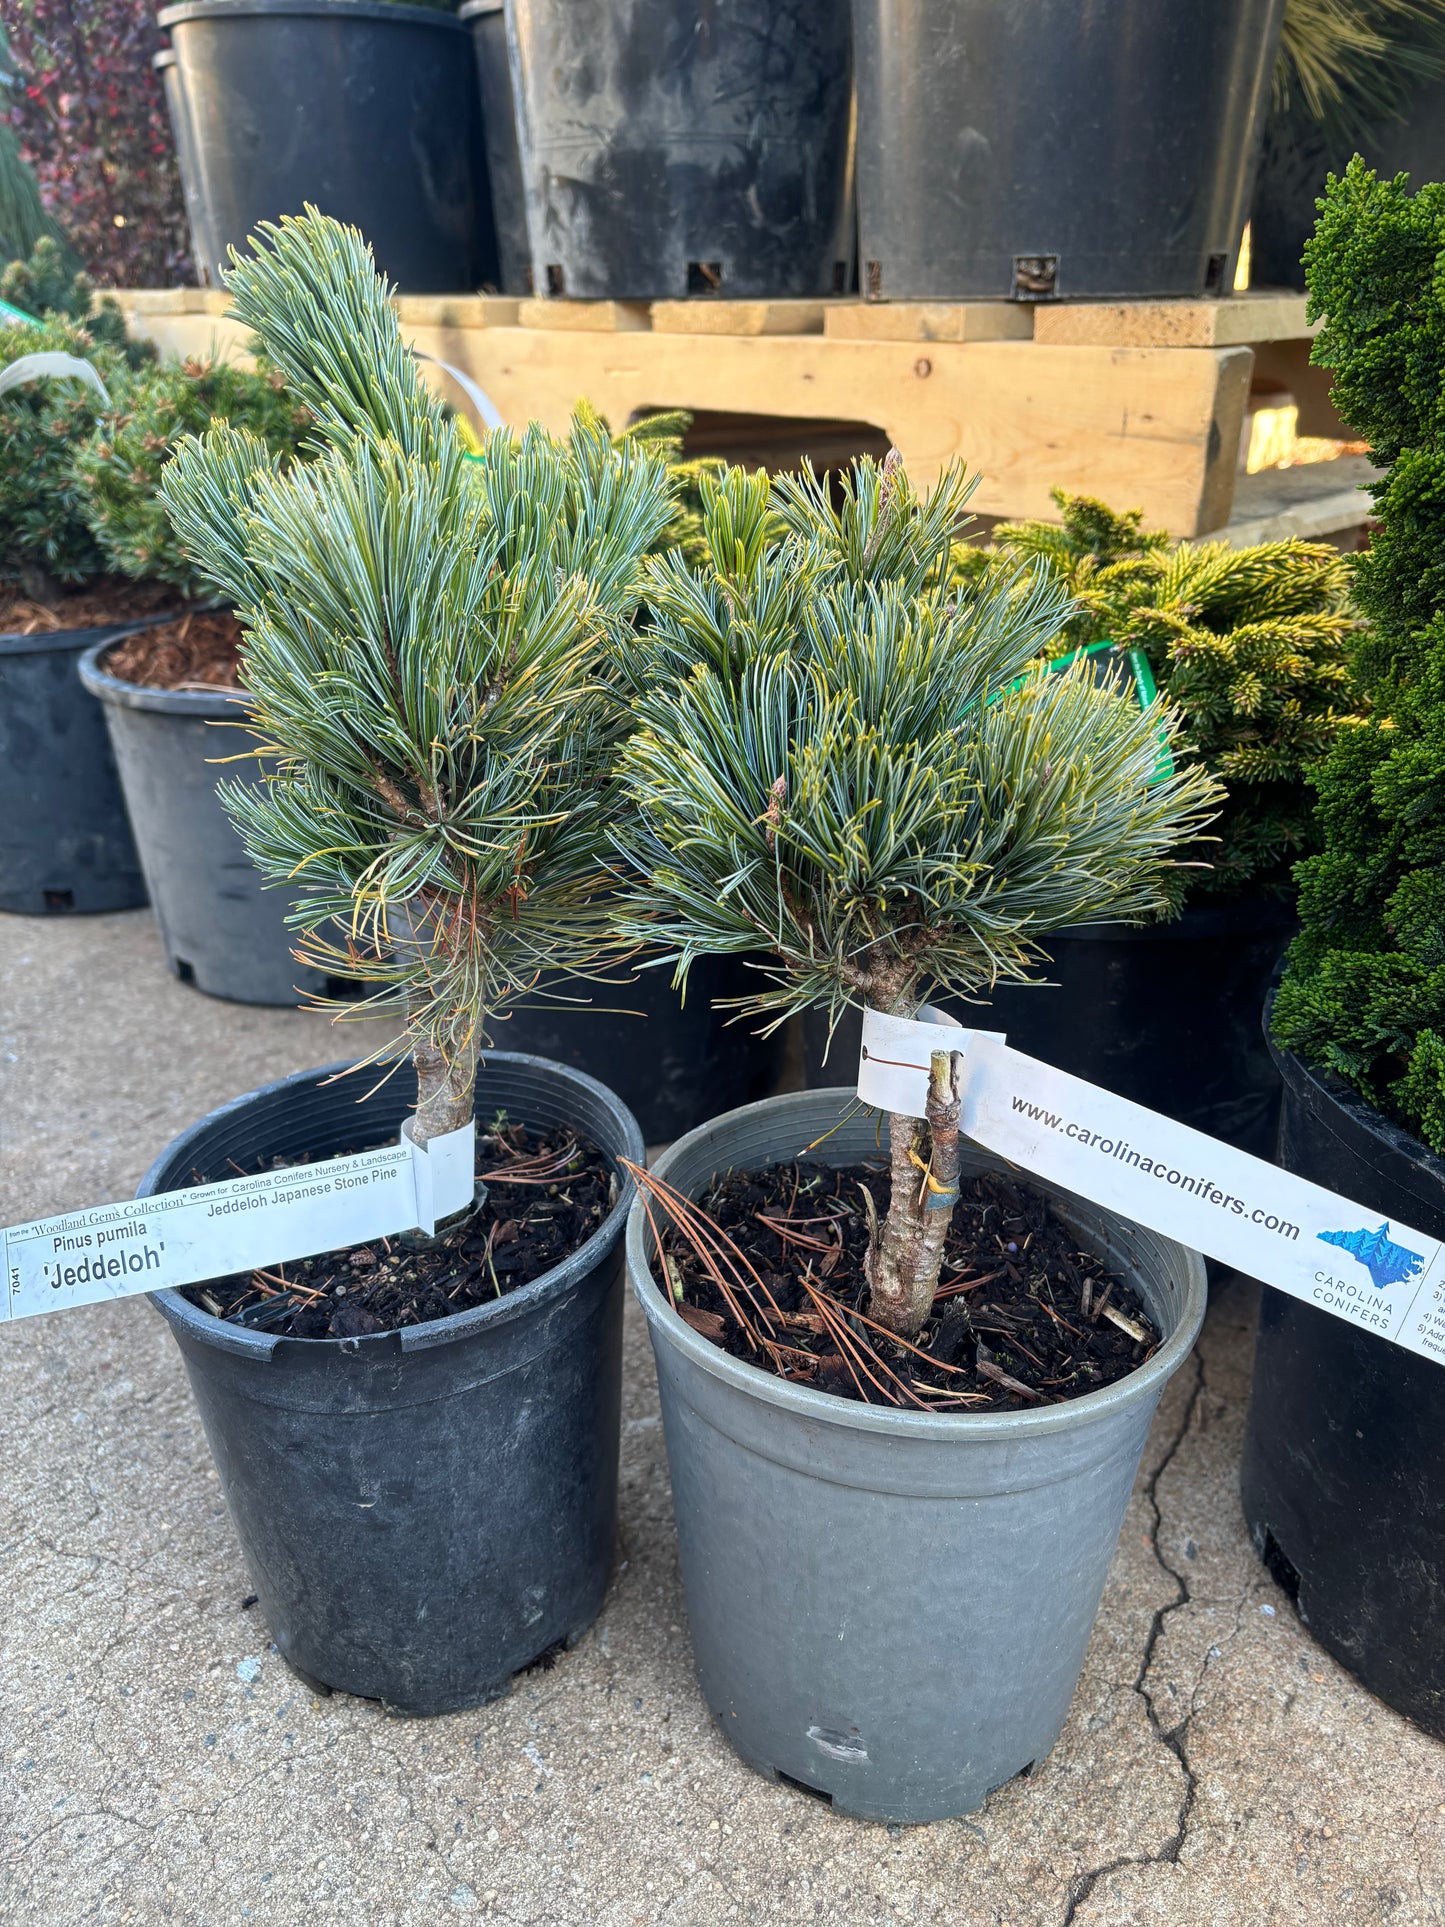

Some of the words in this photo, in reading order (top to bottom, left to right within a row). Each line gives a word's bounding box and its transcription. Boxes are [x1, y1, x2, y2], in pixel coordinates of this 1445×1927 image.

[1012, 1096, 1300, 1241] www.carolinaconifers.com
[31, 1215, 87, 1236] "Woodland
[124, 1194, 187, 1217] Collection"
[190, 1189, 216, 1200] Grown
[217, 1186, 228, 1195] for
[231, 1178, 272, 1193] Carolina
[274, 1170, 313, 1185] Conifers
[315, 1161, 350, 1177] Nursery
[352, 1159, 360, 1168] &
[361, 1150, 407, 1167] Landscape
[207, 1195, 268, 1217] Jeddeloh
[271, 1183, 331, 1205] Japanese
[334, 1173, 369, 1191] Stone
[372, 1167, 398, 1183] Pine
[53, 1233, 93, 1253] Pinus
[97, 1221, 148, 1247] pumila
[11, 1267, 21, 1296] 7041
[43, 1241, 165, 1289] 'Jeddeloh'
[1313, 1288, 1390, 1330] CONIFERS
[1314, 1271, 1393, 1315] CAROLINA
[1432, 1291, 1443, 1302] 3)
[1417, 1323, 1427, 1335] 5)
[1427, 1328, 1444, 1341] Add
[1423, 1312, 1432, 1323] 4)
